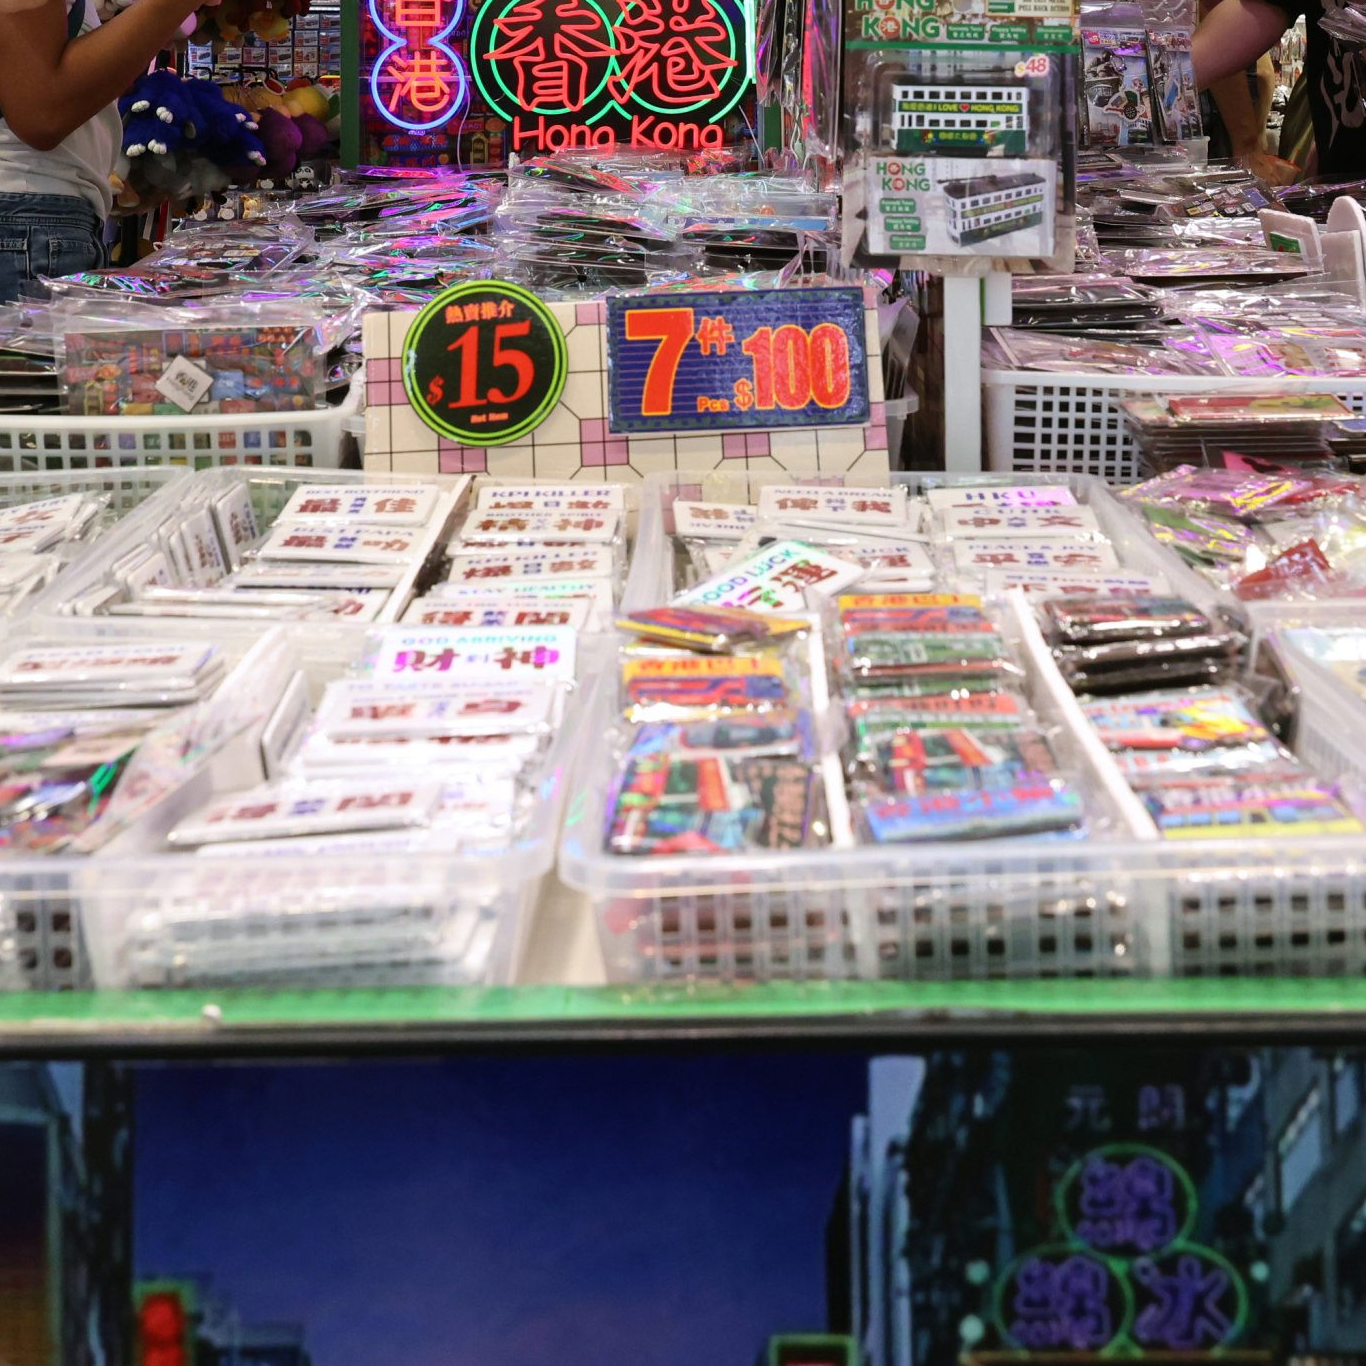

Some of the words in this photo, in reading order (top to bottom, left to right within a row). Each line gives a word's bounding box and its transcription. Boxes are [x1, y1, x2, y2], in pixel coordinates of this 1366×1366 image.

[863, 15, 940, 38] KONG
[938, 103, 958, 112] LOVE
[971, 103, 995, 113] HONG
[996, 103, 1020, 113] KONG
[511, 114, 616, 153] Hong
[630, 113, 724, 151] Kong
[876, 162, 925, 175] HONG
[881, 178, 930, 192] KONG
[624, 307, 695, 417] 7
[696, 316, 734, 356] 件
[733, 322, 850, 412] $100
[697, 397, 729, 413] Pcs
[965, 490, 1036, 501] HKU
[745, 549, 802, 577] LUCK
[401, 636, 450, 646] GOD
[456, 634, 558, 645] ARRIVING
